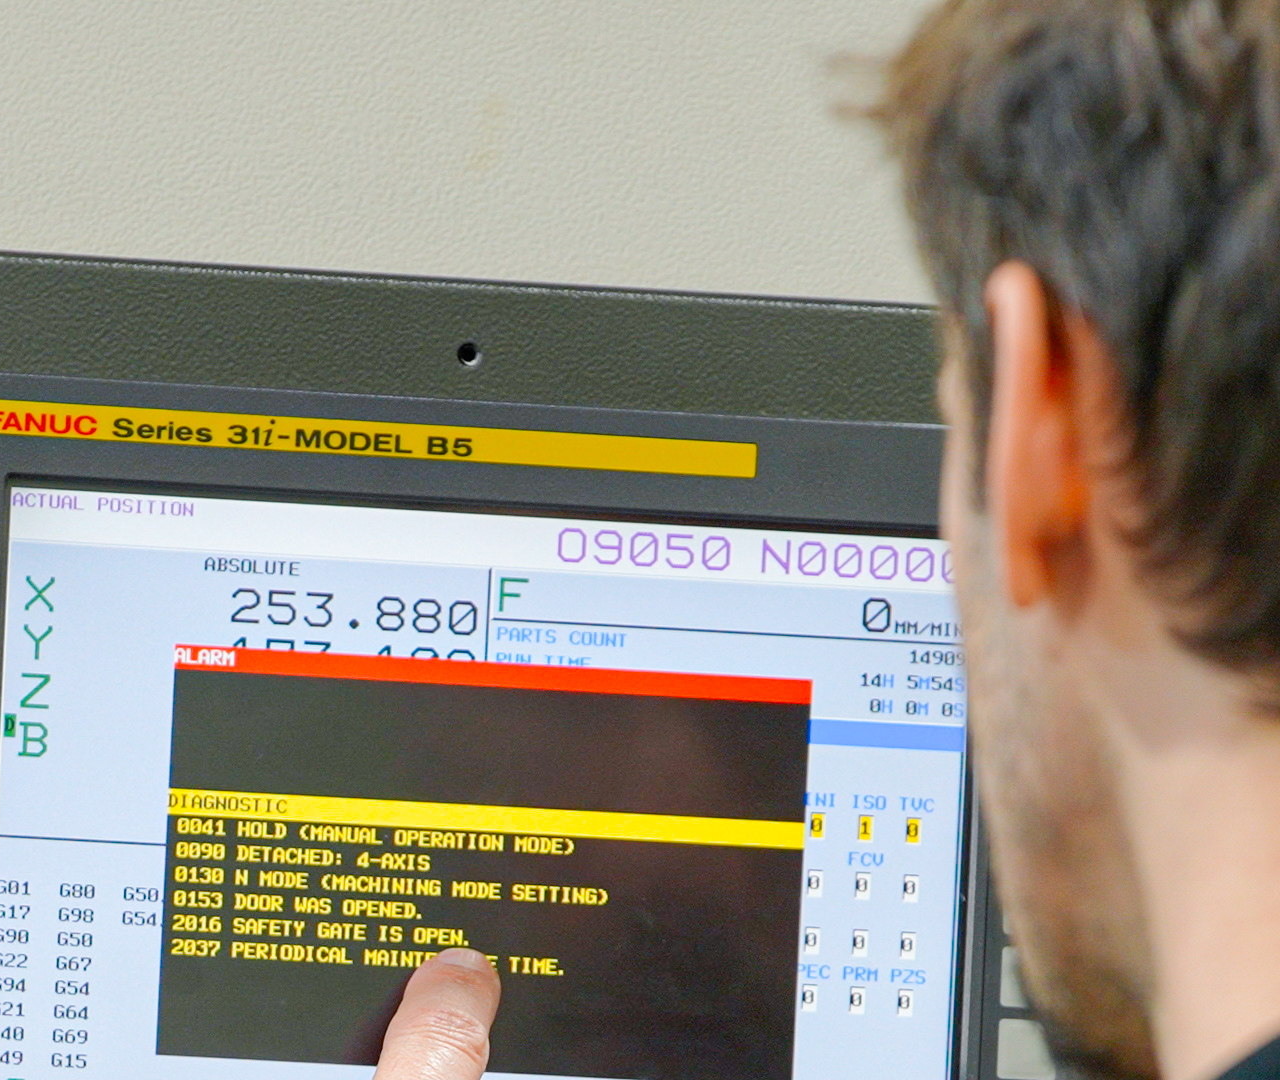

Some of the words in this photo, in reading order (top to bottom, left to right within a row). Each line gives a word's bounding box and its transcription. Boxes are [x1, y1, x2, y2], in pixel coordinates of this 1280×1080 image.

[113, 417, 213, 443] Series
[427, 436, 473, 457] B5
[12, 492, 84, 511] ACTUAL
[97, 495, 195, 517] POSITION
[204, 556, 301, 577] ABSOLUTE
[25, 575, 55, 612] X
[499, 577, 529, 612] F
[231, 587, 478, 636] 253.880
[24, 624, 53, 660] Y
[496, 626, 557, 644] PARTS
[569, 630, 628, 648] COUNT
[174, 646, 236, 668] ALARM
[20, 672, 51, 709] Z
[168, 794, 288, 814] DIAGNOSTIC
[852, 794, 887, 811] ISO
[899, 796, 935, 813] TVC
[176, 817, 227, 837] 0041
[236, 820, 288, 840] HOLD
[299, 823, 383, 845] (MANUAL
[394, 829, 504, 852] OPERATION
[514, 836, 575, 856] MODE)
[175, 841, 226, 861] 0090
[236, 845, 342, 866] DETACHED:
[356, 851, 431, 872] 4-AXIS
[848, 851, 884, 867] FCV
[60, 883, 96, 899] G80
[174, 865, 225, 885] 0130
[235, 869, 249, 887] N
[258, 870, 309, 890] MODE
[321, 874, 442, 897] (MACHINING
[452, 881, 502, 900] MODE
[512, 883, 609, 906] SETTING)
[58, 908, 94, 924] G98
[173, 890, 223, 909] 0153
[233, 893, 284, 913] DOOR
[294, 896, 333, 915] WAS
[342, 899, 422, 920] OPENED.
[57, 931, 93, 948] G50
[172, 914, 222, 934] 2016
[232, 917, 305, 938] SAFETY
[317, 922, 367, 941] GATE
[379, 925, 403, 943] IS
[413, 927, 470, 946] OPEN.
[56, 956, 92, 972] G67
[171, 938, 221, 958] 2037
[231, 942, 353, 965] PERIODICAL
[509, 956, 565, 976] TIME.
[842, 965, 879, 982] PRM
[890, 968, 927, 985] PZS
[54, 980, 90, 996] G54
[53, 1004, 89, 1020] G64
[52, 1028, 88, 1044] G69
[51, 1052, 87, 1069] G15
